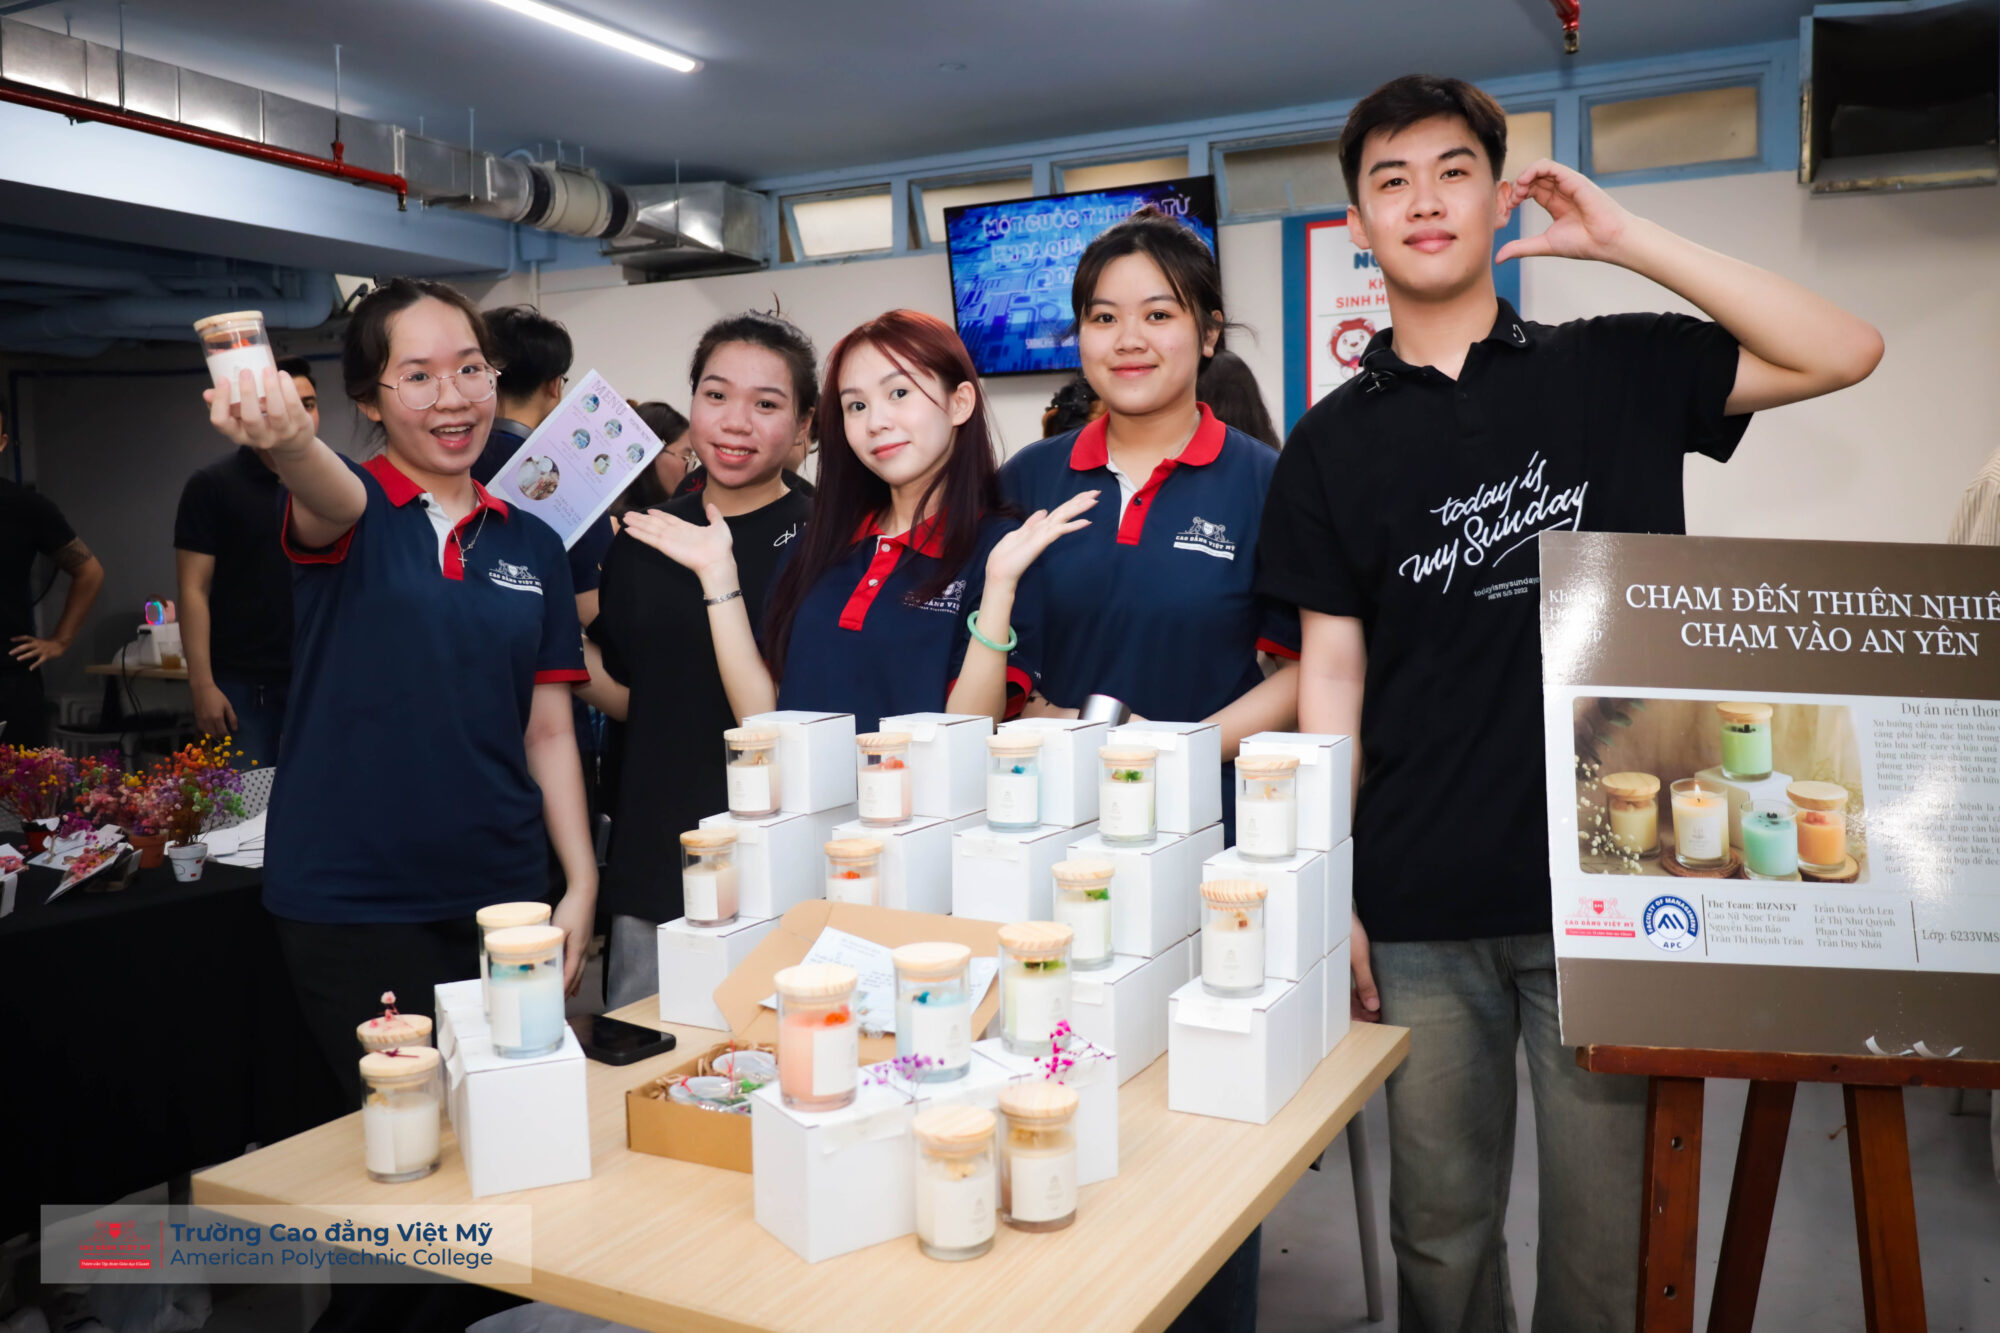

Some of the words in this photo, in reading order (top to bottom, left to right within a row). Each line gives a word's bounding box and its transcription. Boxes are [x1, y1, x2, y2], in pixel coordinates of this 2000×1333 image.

[1335, 295, 1371, 309] SINH
[1368, 278, 1385, 290] KH
[591, 379, 629, 416] MENU
[1430, 475, 1518, 526] today
[1520, 450, 1547, 492] is
[1399, 537, 1459, 595] my
[1625, 584, 1723, 615] CHẠM
[1807, 586, 1913, 618] THIÊN
[1920, 590, 2000, 621] NHIÊ
[1681, 621, 1779, 653] CHẠM
[1785, 620, 1852, 652] VÀO
[1860, 628, 1906, 654] AN
[1912, 624, 1980, 657] YÊN
[1645, 904, 1656, 933] FACULTY
[1664, 897, 1697, 933] MANAGEMENT
[1706, 900, 1724, 910] The
[1756, 901, 1798, 912] BIZNEST
[1663, 941, 1682, 949] APC
